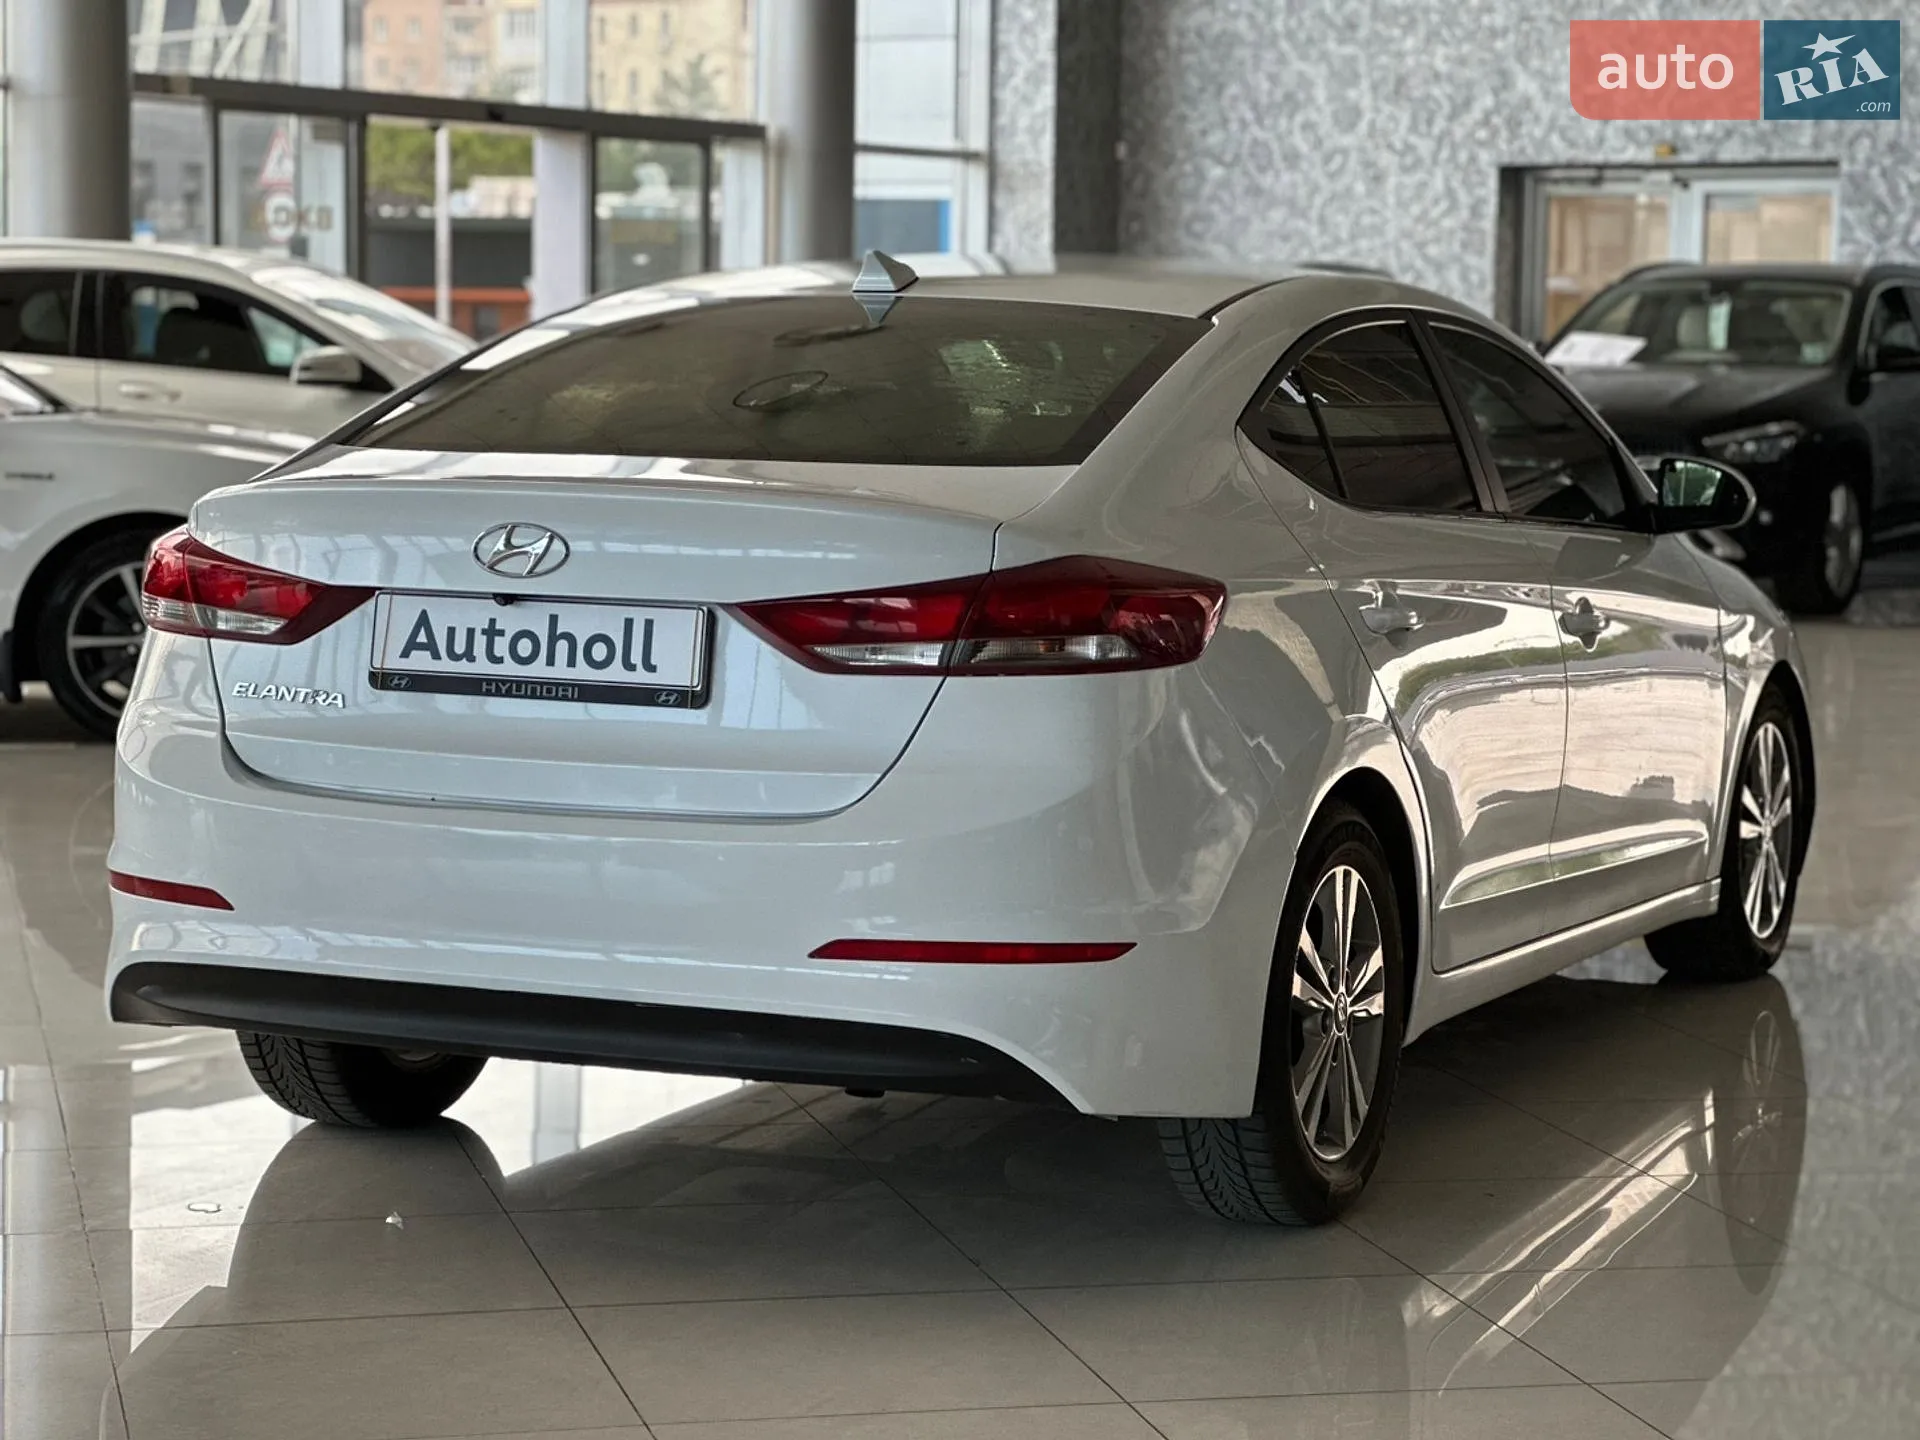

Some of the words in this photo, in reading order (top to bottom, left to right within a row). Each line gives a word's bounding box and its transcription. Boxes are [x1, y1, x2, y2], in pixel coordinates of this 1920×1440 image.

[398, 608, 658, 674] Autoholl
[231, 682, 345, 709] ELANTRA
[481, 680, 580, 700] HYUNDAI
